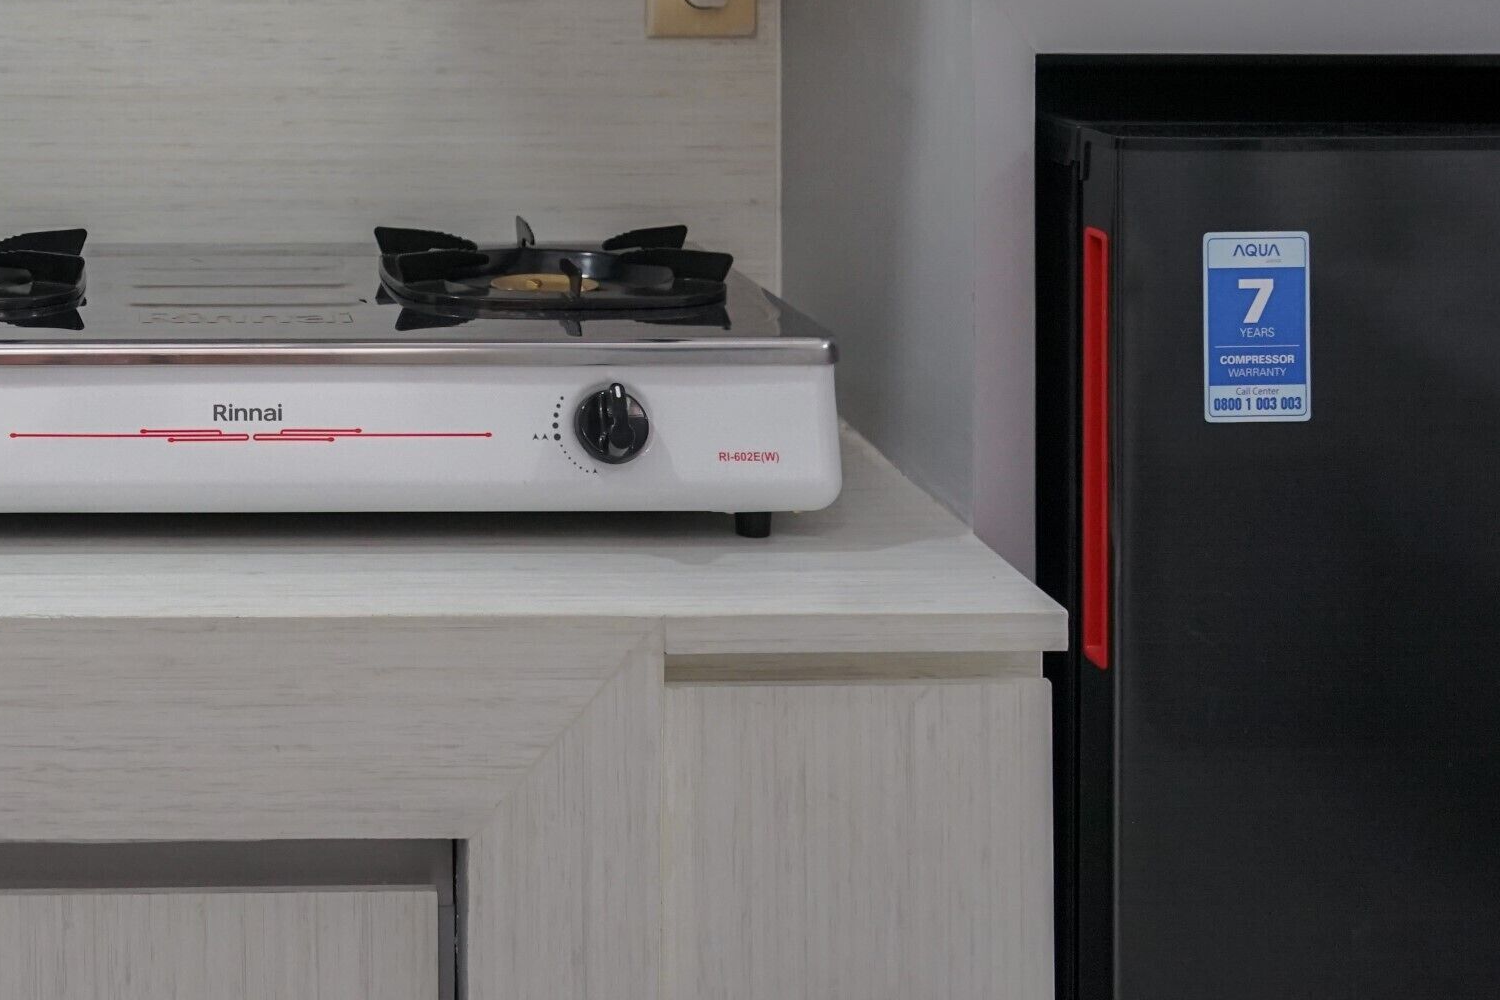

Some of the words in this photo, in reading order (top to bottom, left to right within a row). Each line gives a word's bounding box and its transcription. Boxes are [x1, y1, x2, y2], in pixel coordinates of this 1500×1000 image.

[1233, 243, 1280, 257] AQUA
[1238, 278, 1274, 324] 7
[1240, 327, 1275, 338] YEARS
[1220, 354, 1295, 365] COMPRESSOR
[1228, 367, 1287, 378] WARRANTY
[1236, 387, 1251, 396] Call
[1252, 387, 1280, 396] Center
[1214, 397, 1242, 411] 0800
[1245, 397, 1251, 411] 1
[1256, 397, 1277, 410] 003
[1280, 396, 1302, 410] 003
[213, 403, 283, 421] Rinnai
[718, 451, 780, 464] RI-602E(W)
